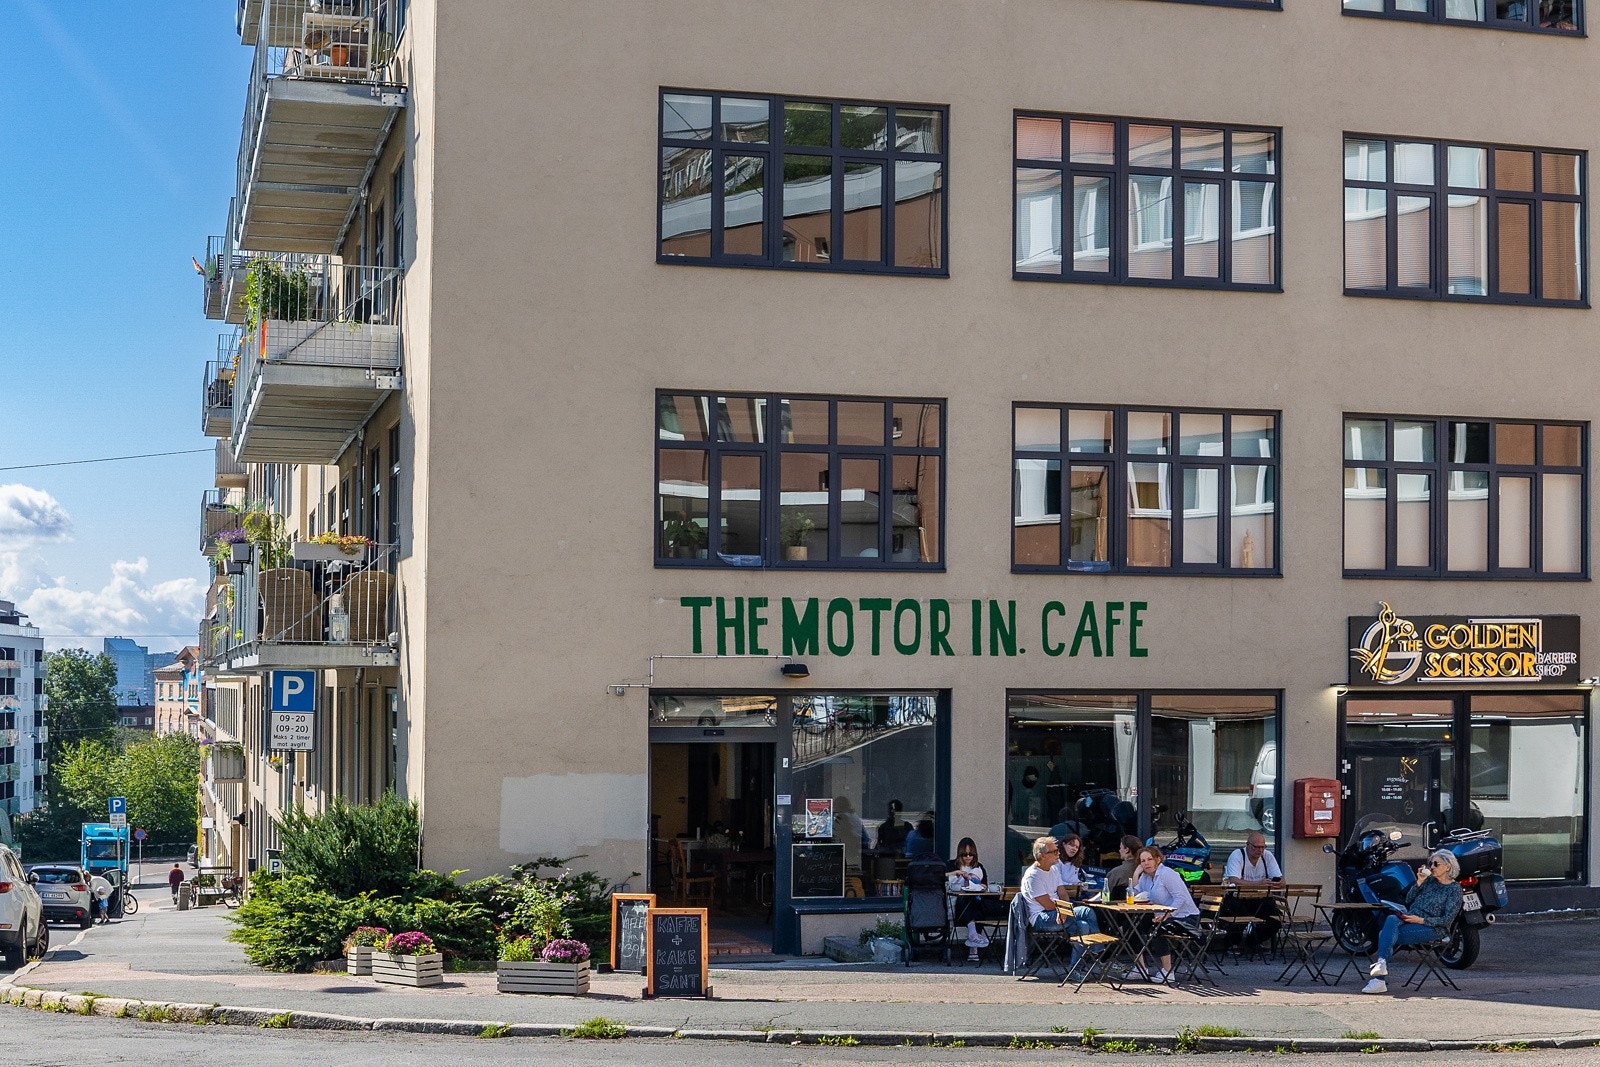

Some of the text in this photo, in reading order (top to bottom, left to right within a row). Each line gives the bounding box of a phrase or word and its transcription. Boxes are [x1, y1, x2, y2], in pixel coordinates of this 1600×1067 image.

[680, 596, 769, 656] THE
[781, 597, 956, 657] MOTOR
[1041, 600, 1149, 658] CAFE
[1424, 623, 1537, 650] GOLDEN
[1399, 639, 1423, 652] THE
[1423, 651, 1537, 678] SCISSOR
[1536, 651, 1578, 664] BARBER
[1535, 664, 1567, 676] SHOP
[282, 675, 305, 707] P
[112, 799, 122, 812] P
[272, 861, 280, 871] P
[620, 911, 647, 930] VAFLE
[656, 916, 700, 933] KAFFE
[655, 949, 697, 965] KAKE
[658, 974, 700, 990] SANT
